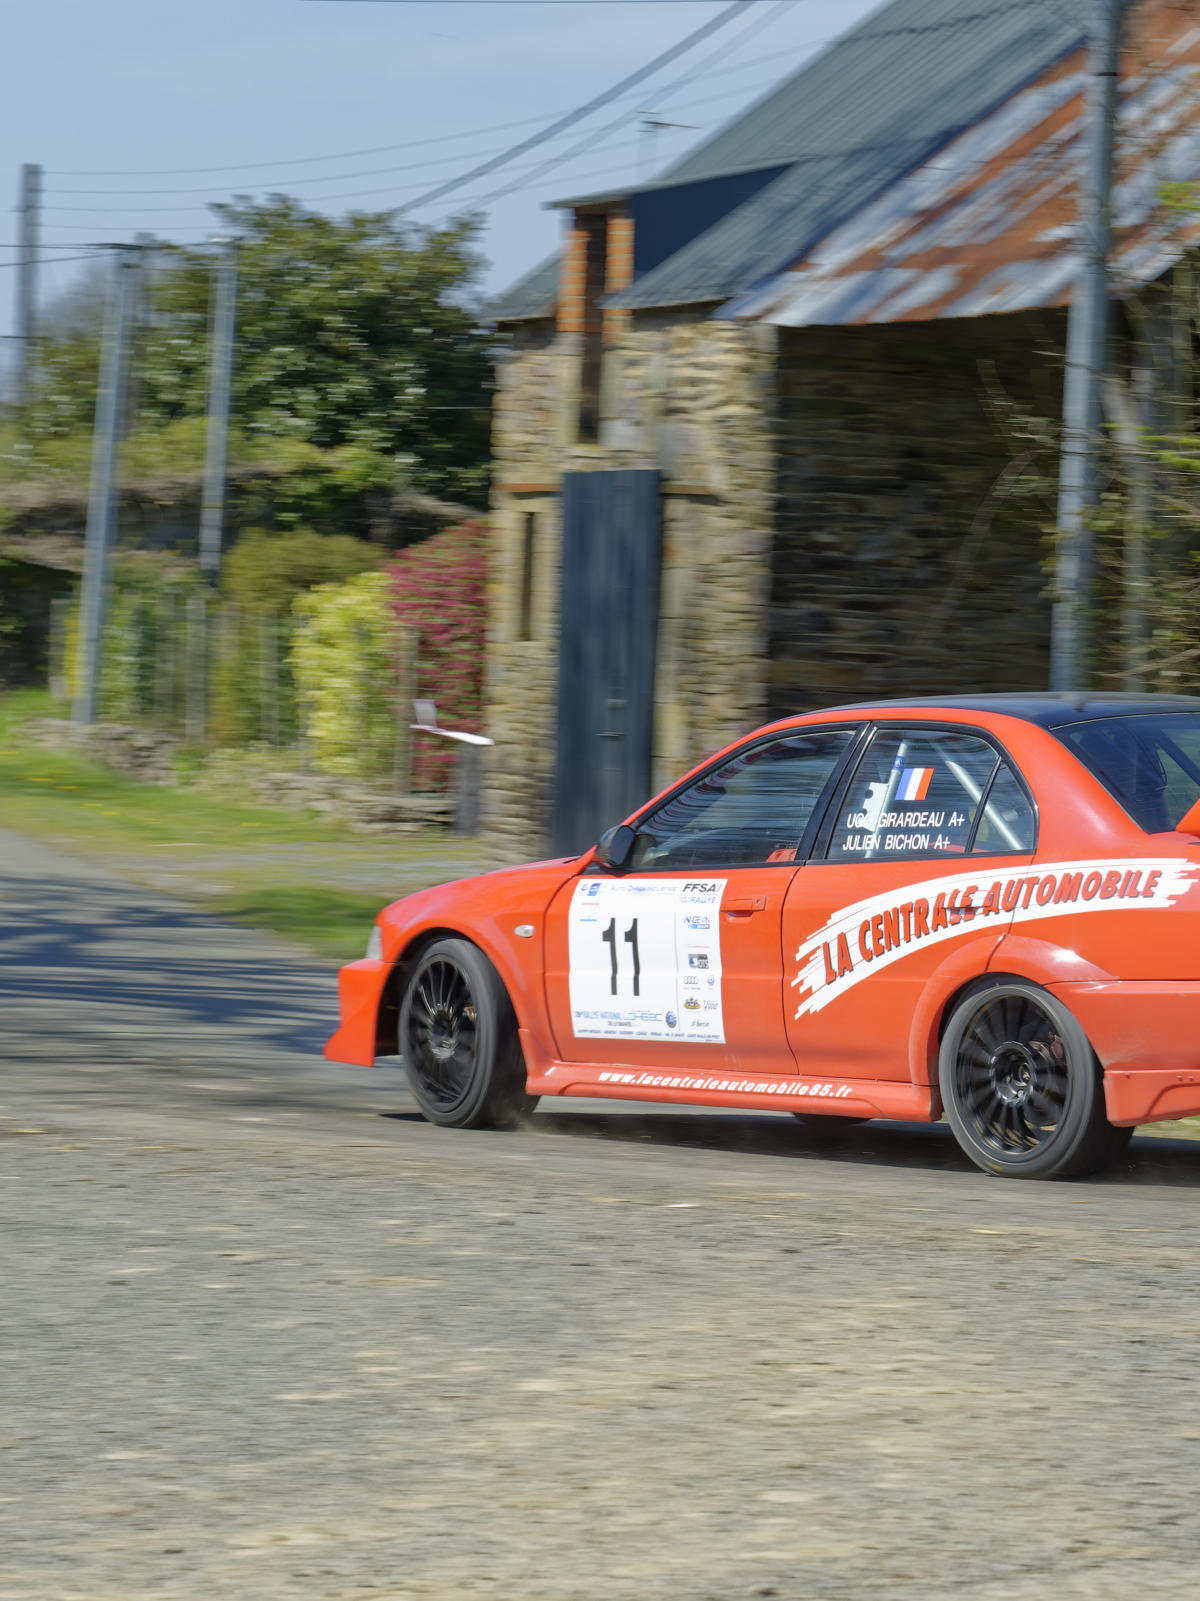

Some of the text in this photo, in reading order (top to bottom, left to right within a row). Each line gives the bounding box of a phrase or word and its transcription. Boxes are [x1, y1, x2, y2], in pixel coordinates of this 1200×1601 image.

[846, 811, 966, 829] UG GIRARDEAU A+
[842, 834, 951, 851] JULIEN BICHON A+
[682, 883, 717, 893] FFSA
[821, 869, 1163, 984] LA CENTRALE AUTOMOBILE
[602, 917, 641, 996] 11
[598, 1071, 853, 1098] www.lacentraleautomobile85.fr
